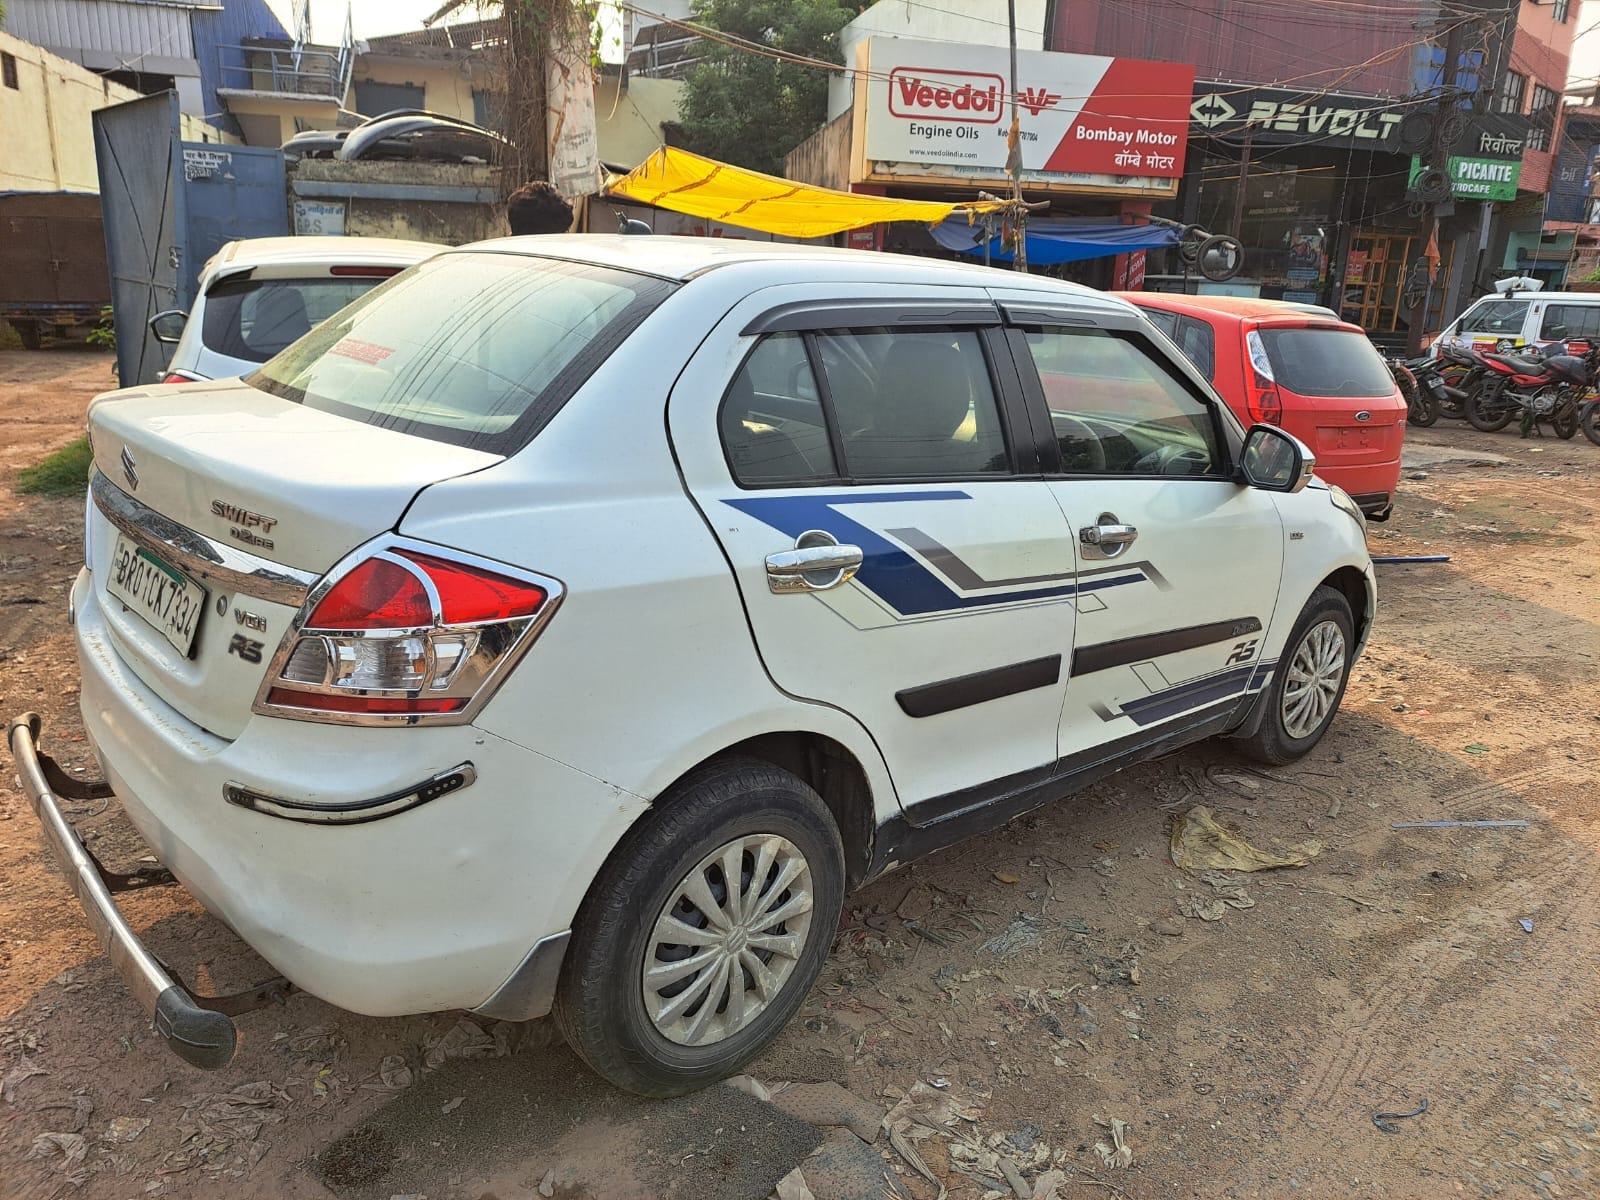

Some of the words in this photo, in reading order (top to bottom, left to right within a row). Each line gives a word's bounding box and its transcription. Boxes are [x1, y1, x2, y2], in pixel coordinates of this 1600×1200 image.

[899, 77, 996, 112] Veedol
[1246, 101, 1403, 139] REVOLT
[909, 123, 952, 139] Engine
[956, 126, 979, 139] Oils
[1076, 125, 1133, 145] Bombay
[1136, 129, 1177, 144] Motor
[1480, 132, 1522, 154] रिवोल्ट
[909, 149, 978, 159] www.veedolindia.com
[1114, 149, 1142, 167] बॉम्बे
[1146, 151, 1175, 168] मोटर
[1458, 162, 1513, 182] PICANTE
[210, 499, 278, 534] SWIFT
[116, 550, 199, 643] BR01CK7334
